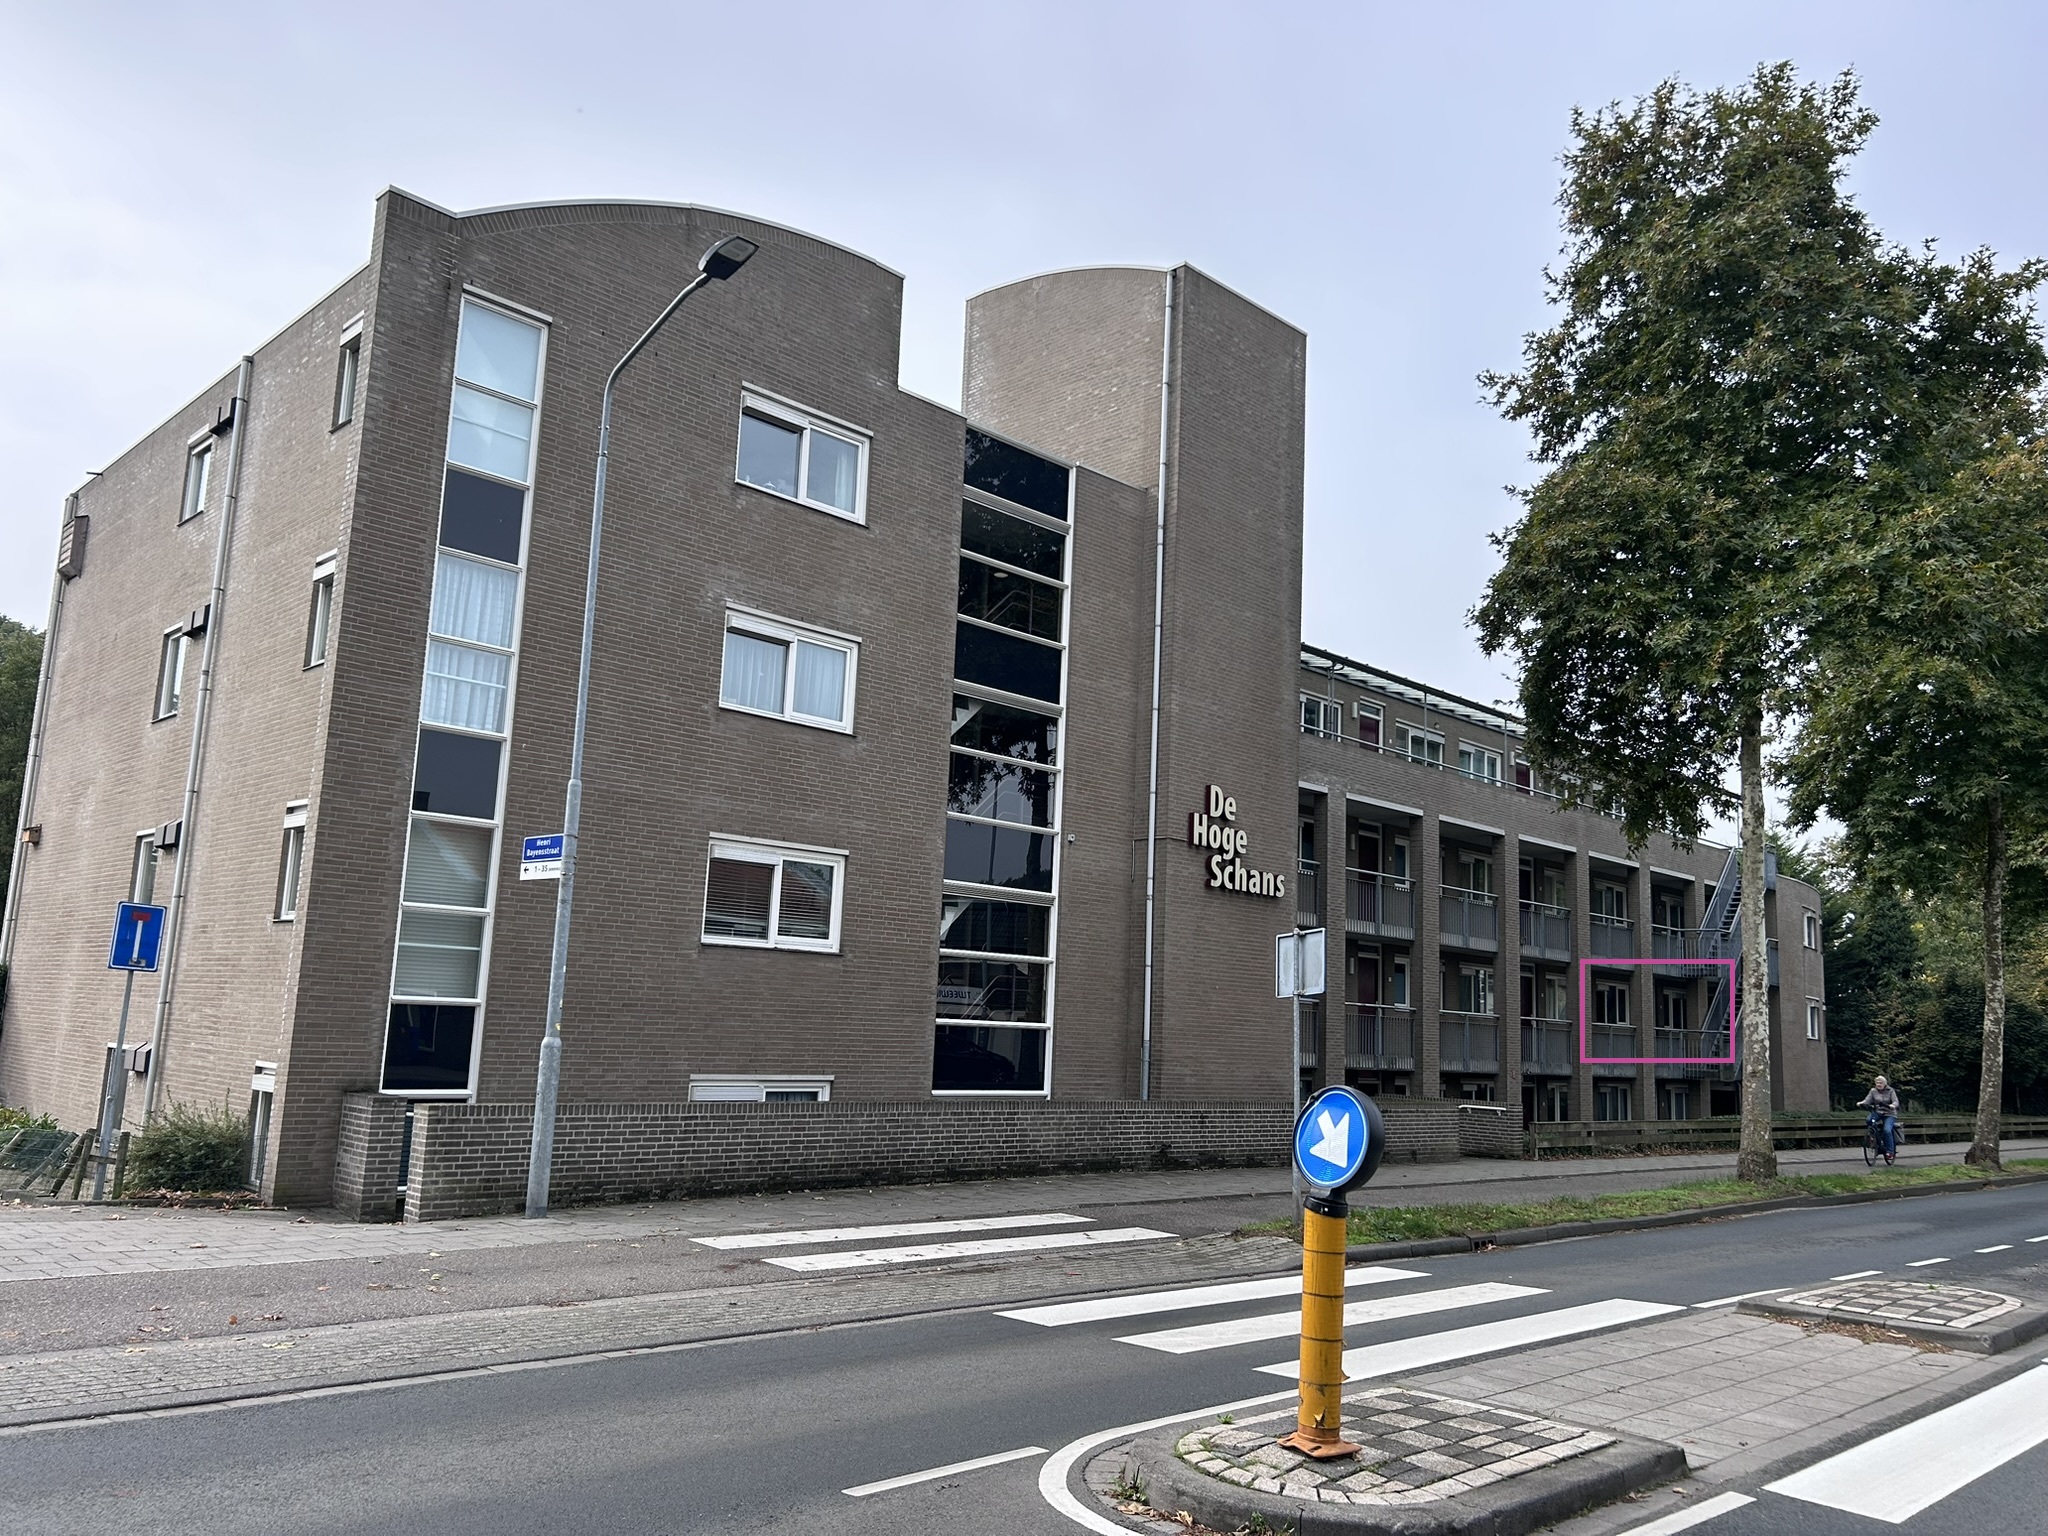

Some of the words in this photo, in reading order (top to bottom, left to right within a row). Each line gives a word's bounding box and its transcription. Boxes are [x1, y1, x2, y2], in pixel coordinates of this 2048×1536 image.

[1209, 784, 1237, 821] De
[526, 847, 560, 857] Bayensstraat
[536, 838, 551, 846] Henri
[1192, 812, 1248, 860] Hoge
[1210, 854, 1285, 898] Schans
